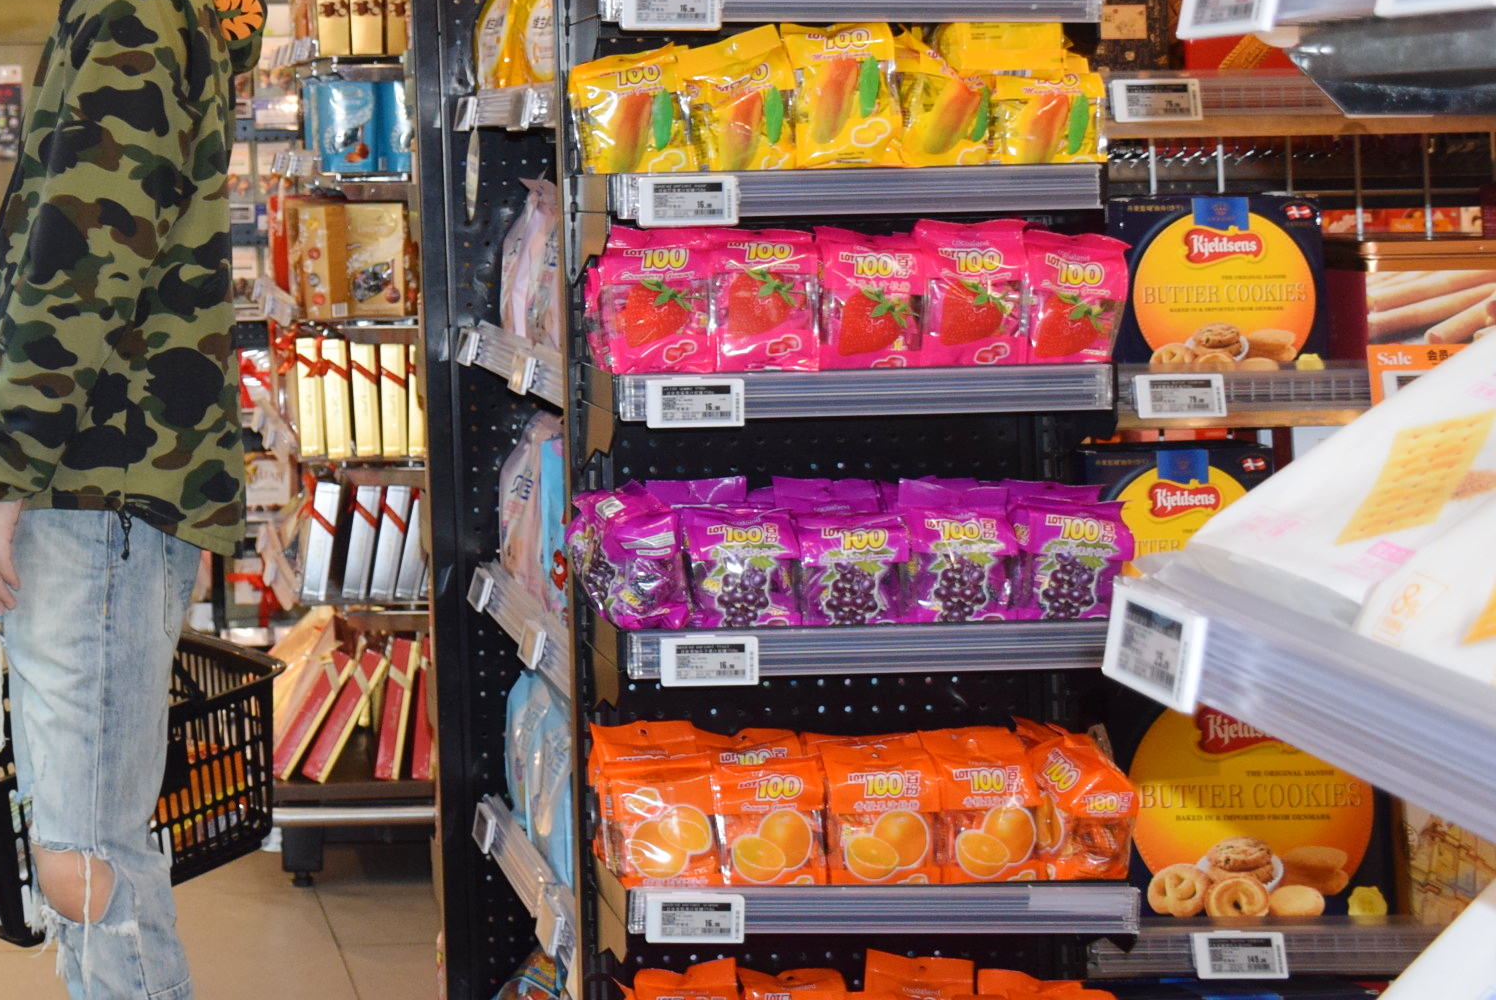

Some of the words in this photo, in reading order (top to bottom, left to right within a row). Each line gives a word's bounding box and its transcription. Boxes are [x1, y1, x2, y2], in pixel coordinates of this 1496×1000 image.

[823, 28, 872, 51] 100
[617, 63, 662, 87] 100
[745, 241, 794, 262] 100
[1190, 234, 1258, 259] Kjeldsens
[641, 248, 689, 272] 100
[854, 254, 895, 277] 100
[954, 247, 1003, 274] 100
[1057, 262, 1104, 287] 100
[1142, 284, 1220, 305] BUTTER
[1223, 281, 1307, 303] COOKIES
[1377, 351, 1413, 366] Sale
[1154, 487, 1216, 512] Kjeldsens
[723, 525, 764, 543] 100
[842, 527, 888, 551] 100
[940, 519, 981, 541] 100
[1060, 517, 1102, 542] 100
[848, 773, 865, 784] LOT
[864, 772, 904, 798] 100
[954, 768, 971, 780] LOT
[969, 766, 1006, 793] 100
[1043, 754, 1081, 793] 100
[755, 775, 803, 801] 100
[1138, 783, 1246, 810] BUTTER
[1252, 781, 1363, 809] COOKIES
